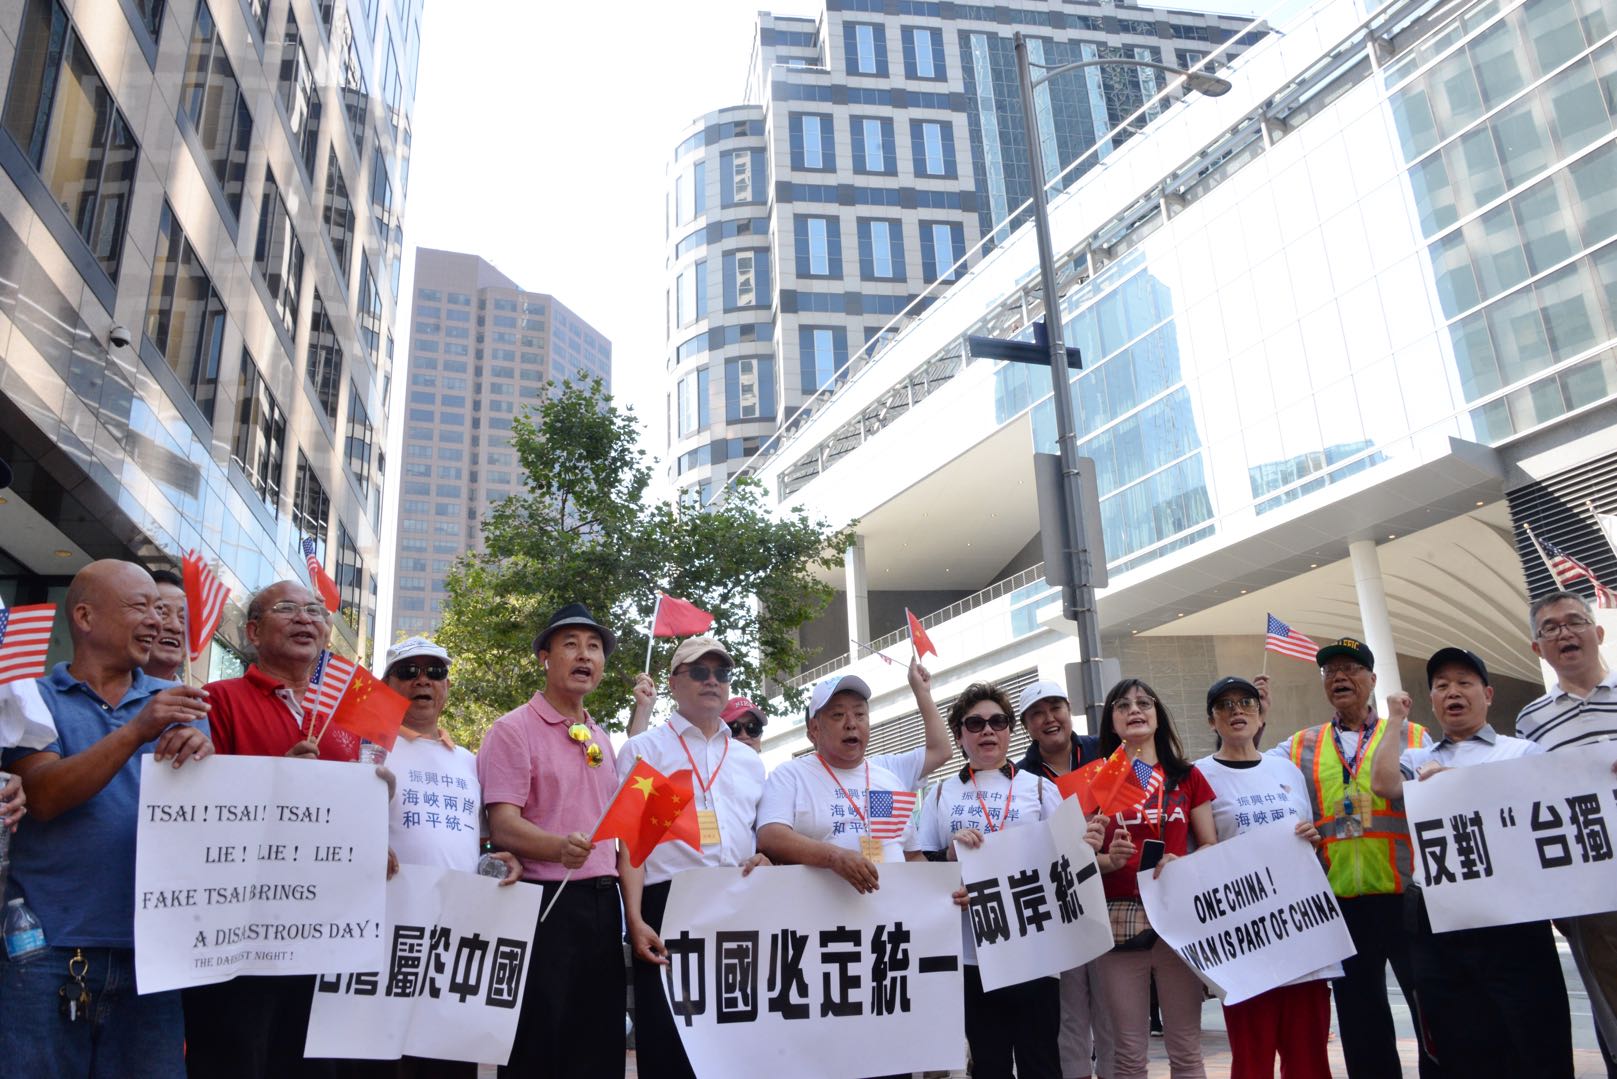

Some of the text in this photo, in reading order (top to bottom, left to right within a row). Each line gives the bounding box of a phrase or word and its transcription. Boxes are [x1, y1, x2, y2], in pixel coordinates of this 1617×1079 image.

[408, 769, 468, 790] 振興中華
[402, 788, 475, 815] 海峽兩岸
[402, 810, 475, 831] 和平統一
[142, 884, 317, 910] FAKE TSAI BRINGS
[966, 854, 1098, 948] 兩岸統一
[1193, 887, 1227, 924] ONE
[193, 930, 207, 948] A
[1218, 929, 1237, 961] IS
[1234, 915, 1271, 955] PART
[1269, 908, 1290, 941] OF
[1288, 891, 1340, 933] CHINA
[194, 957, 214, 968] THE
[318, 924, 528, 1010] 屬於中國
[664, 921, 958, 1027] 中國必定統一
